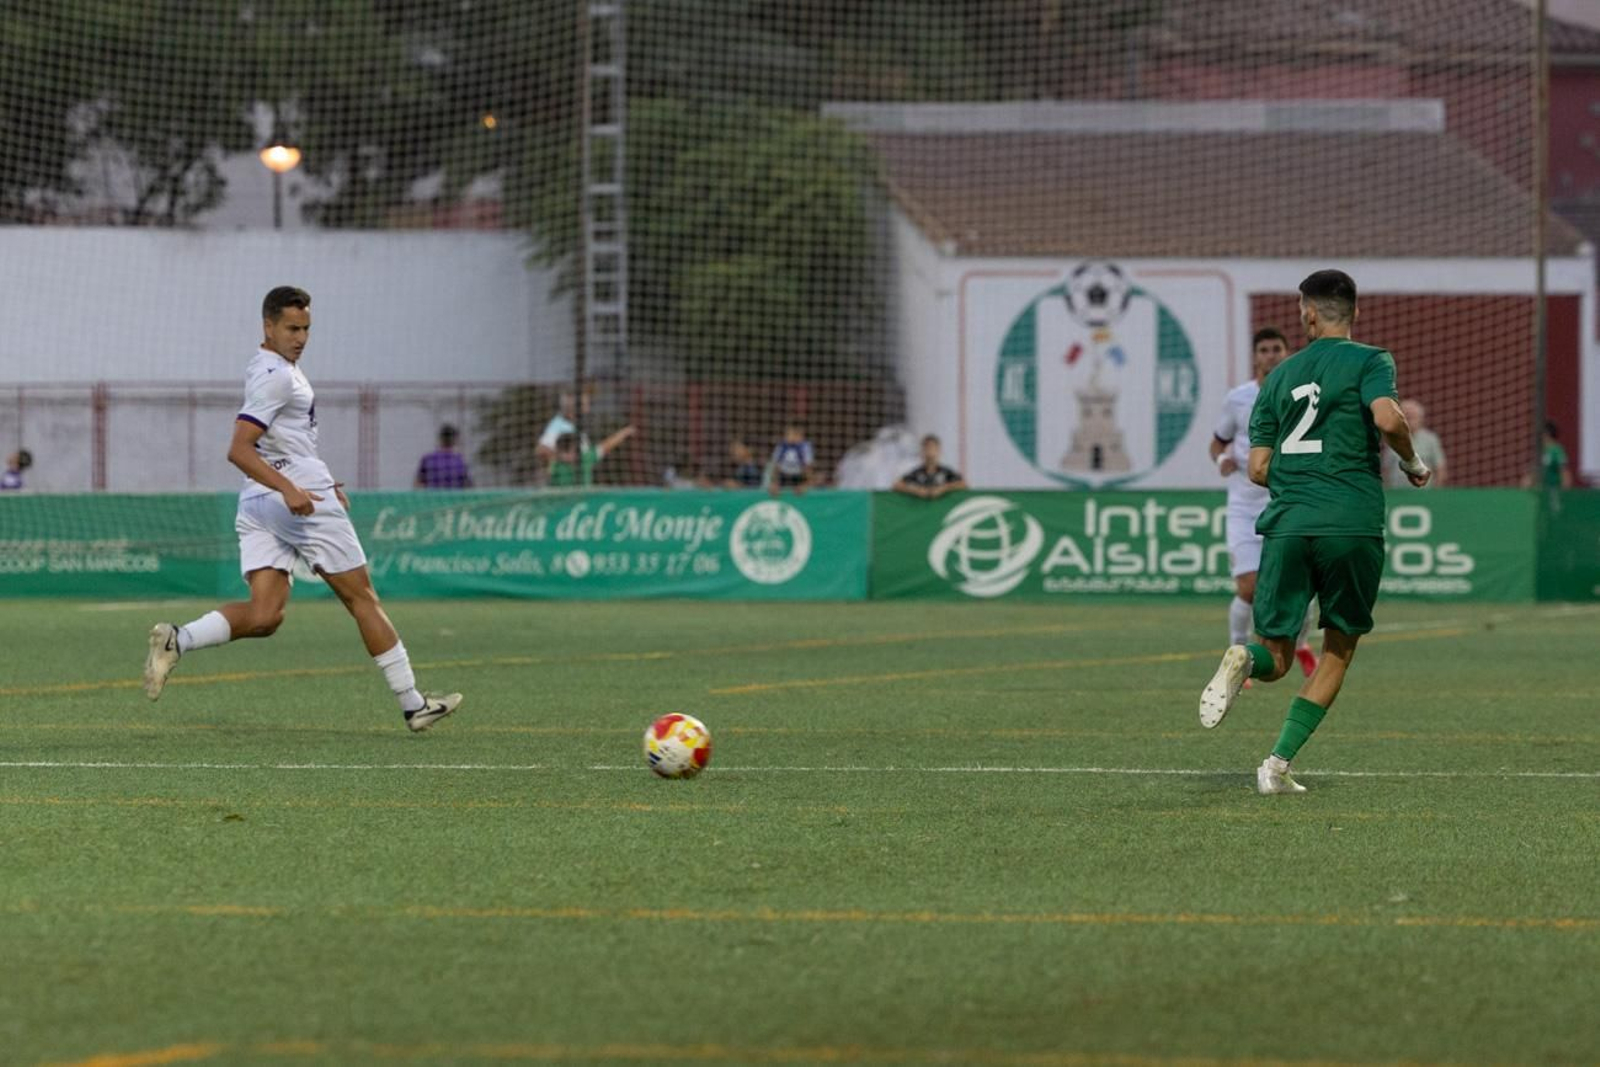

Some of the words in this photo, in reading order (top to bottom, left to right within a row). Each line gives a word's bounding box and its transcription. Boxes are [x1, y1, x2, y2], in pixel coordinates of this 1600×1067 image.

[1281, 382, 1322, 454] 2
[372, 506, 416, 539] La
[555, 502, 615, 541] del
[613, 506, 724, 552] Monje
